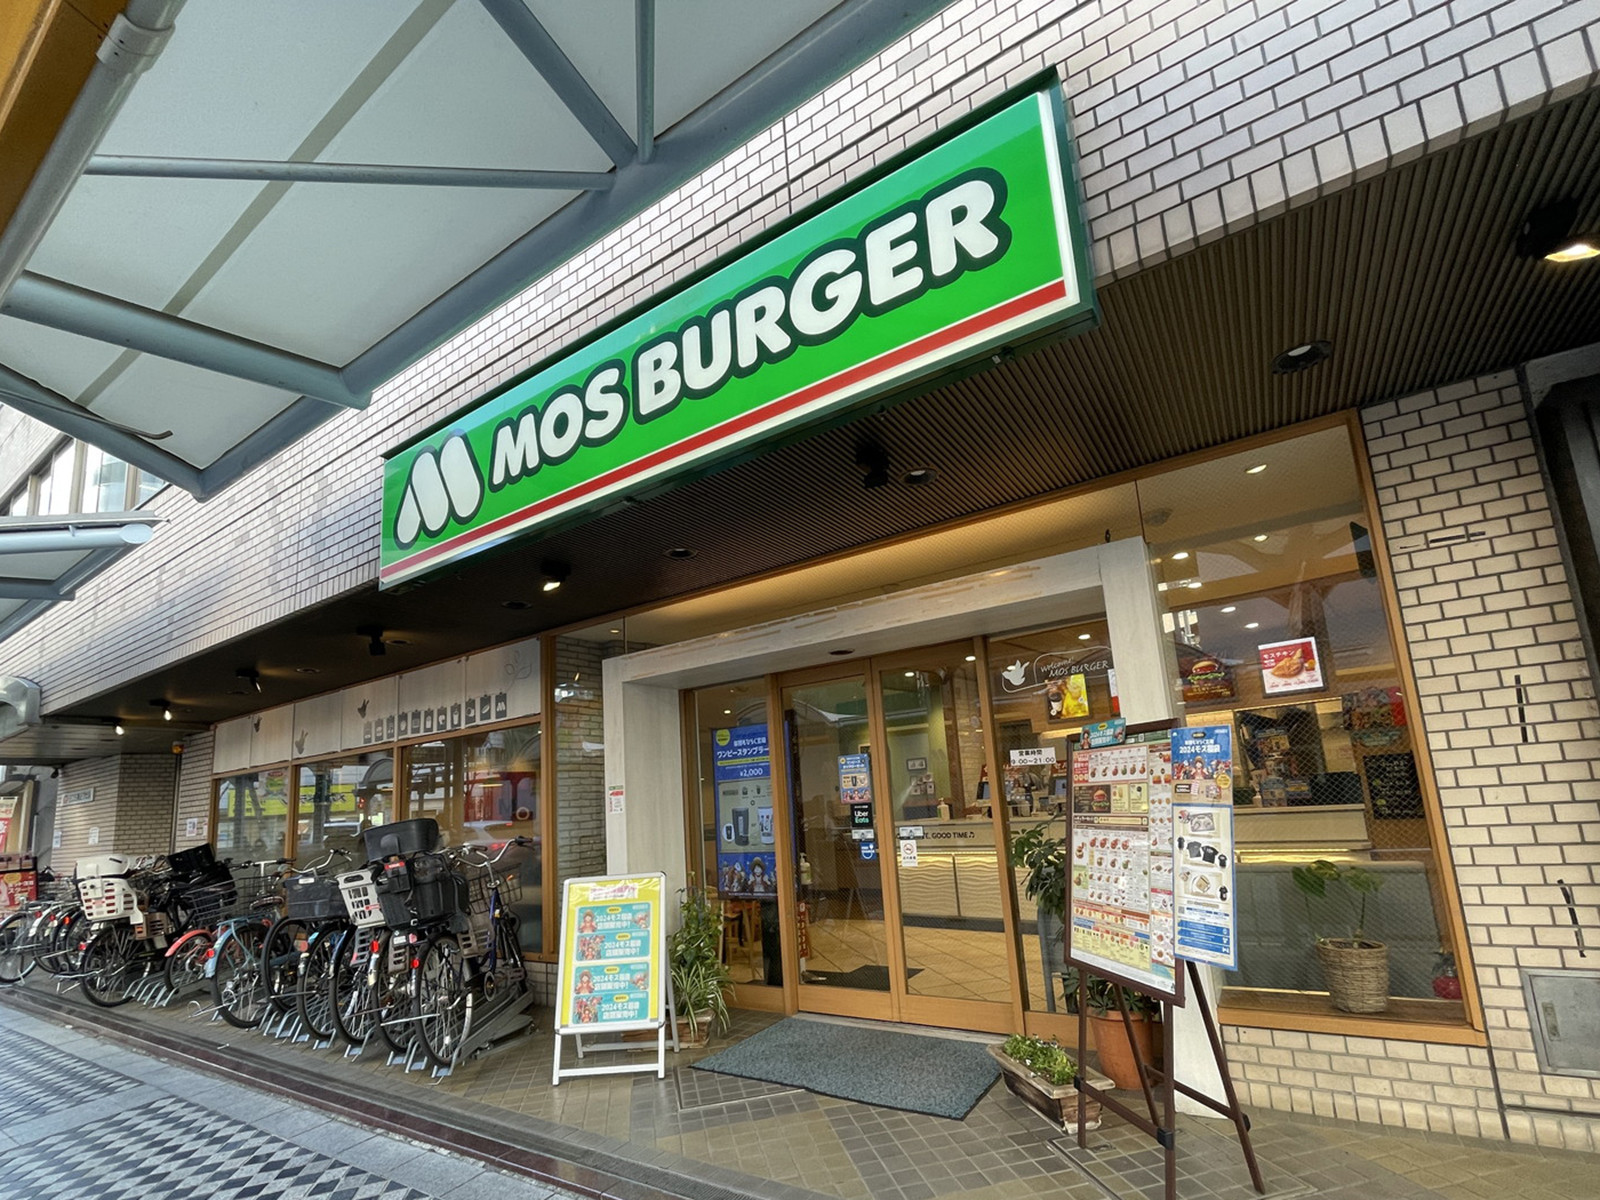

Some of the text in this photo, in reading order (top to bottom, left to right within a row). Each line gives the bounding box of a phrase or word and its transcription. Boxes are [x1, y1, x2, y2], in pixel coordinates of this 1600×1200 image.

[492, 367, 622, 484] MOS
[637, 178, 1000, 416] BURGER
[1263, 650, 1295, 660] モスチキン
[1048, 660, 1109, 678] MOS BURGER
[1018, 749, 1043, 757] 営業時間
